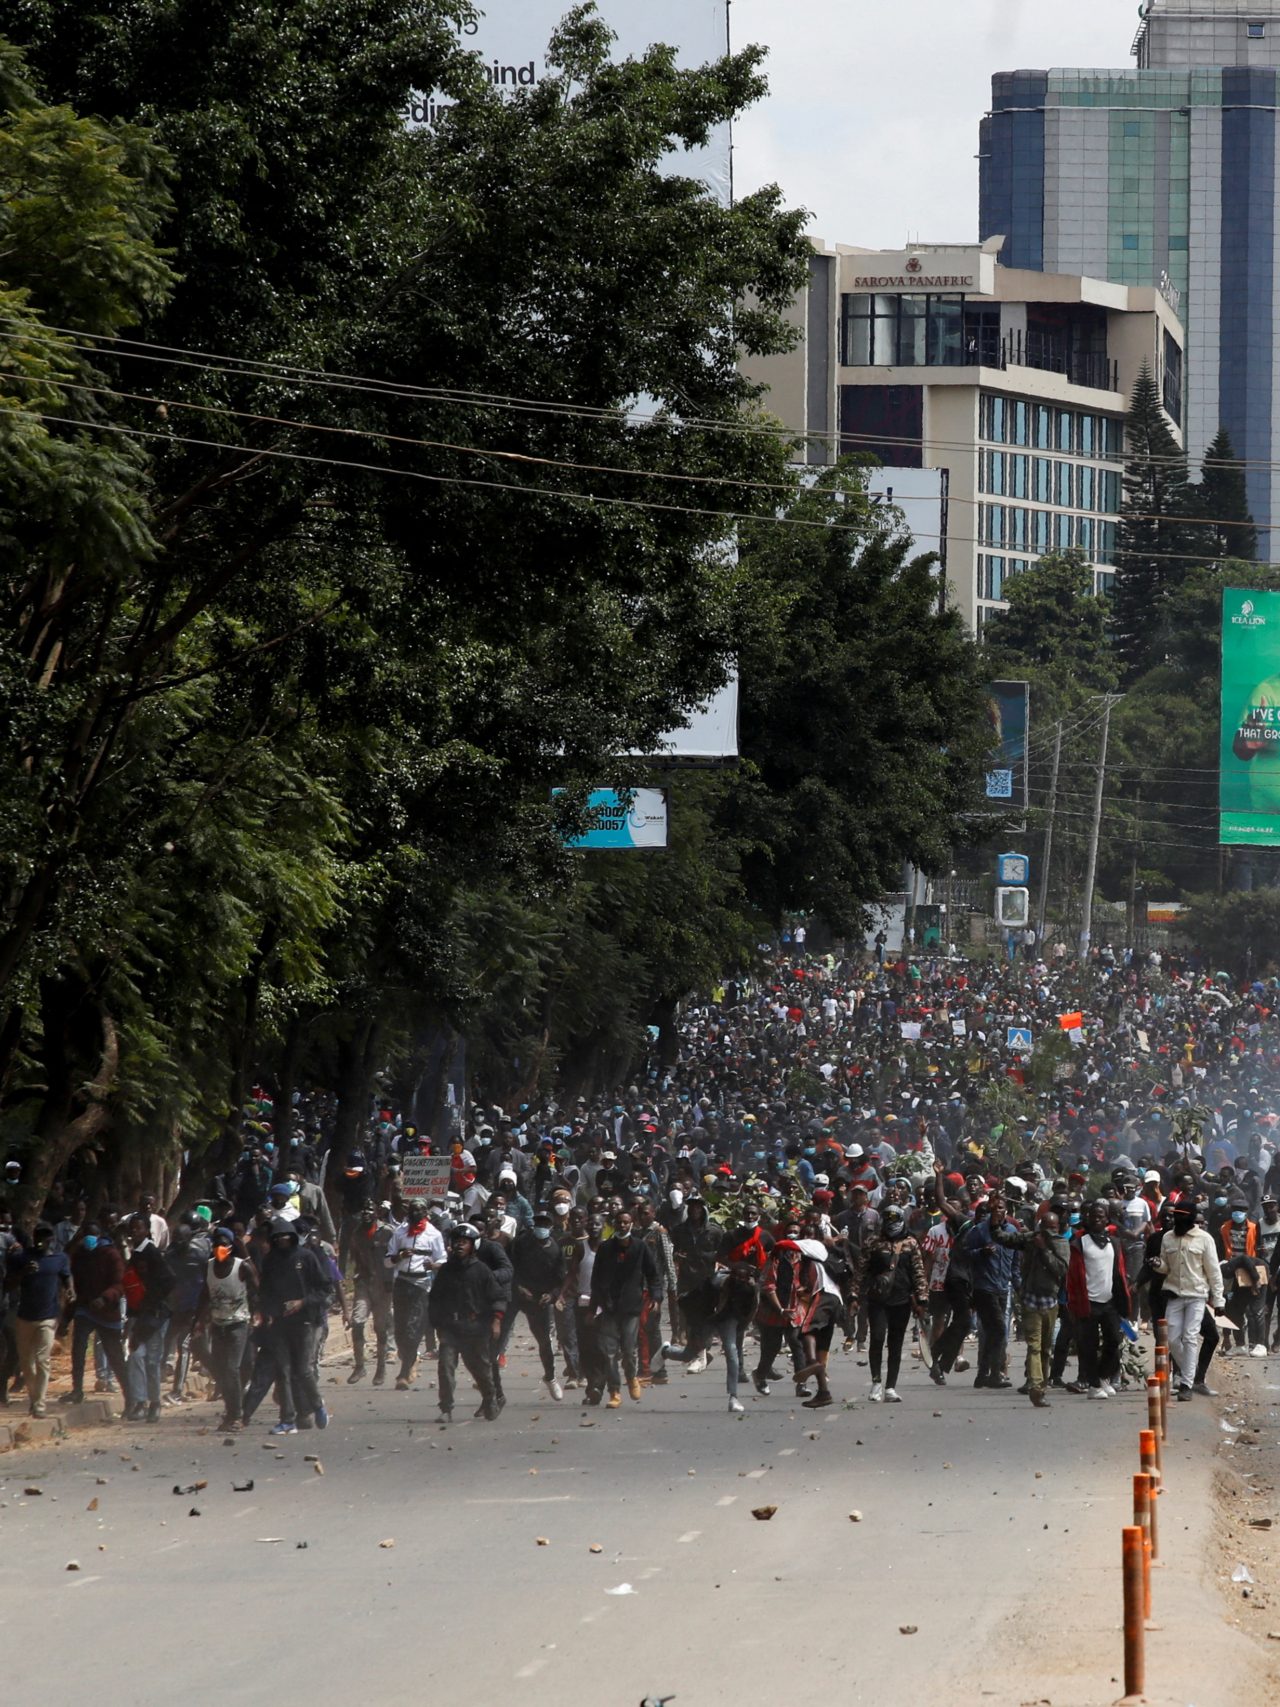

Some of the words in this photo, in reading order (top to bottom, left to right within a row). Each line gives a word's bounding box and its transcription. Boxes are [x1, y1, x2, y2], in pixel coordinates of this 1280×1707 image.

[854, 276, 905, 288] SAROVA
[909, 275, 973, 287] PANAFRIC
[1252, 708, 1274, 721] I'VE
[1238, 727, 1262, 738] THAT
